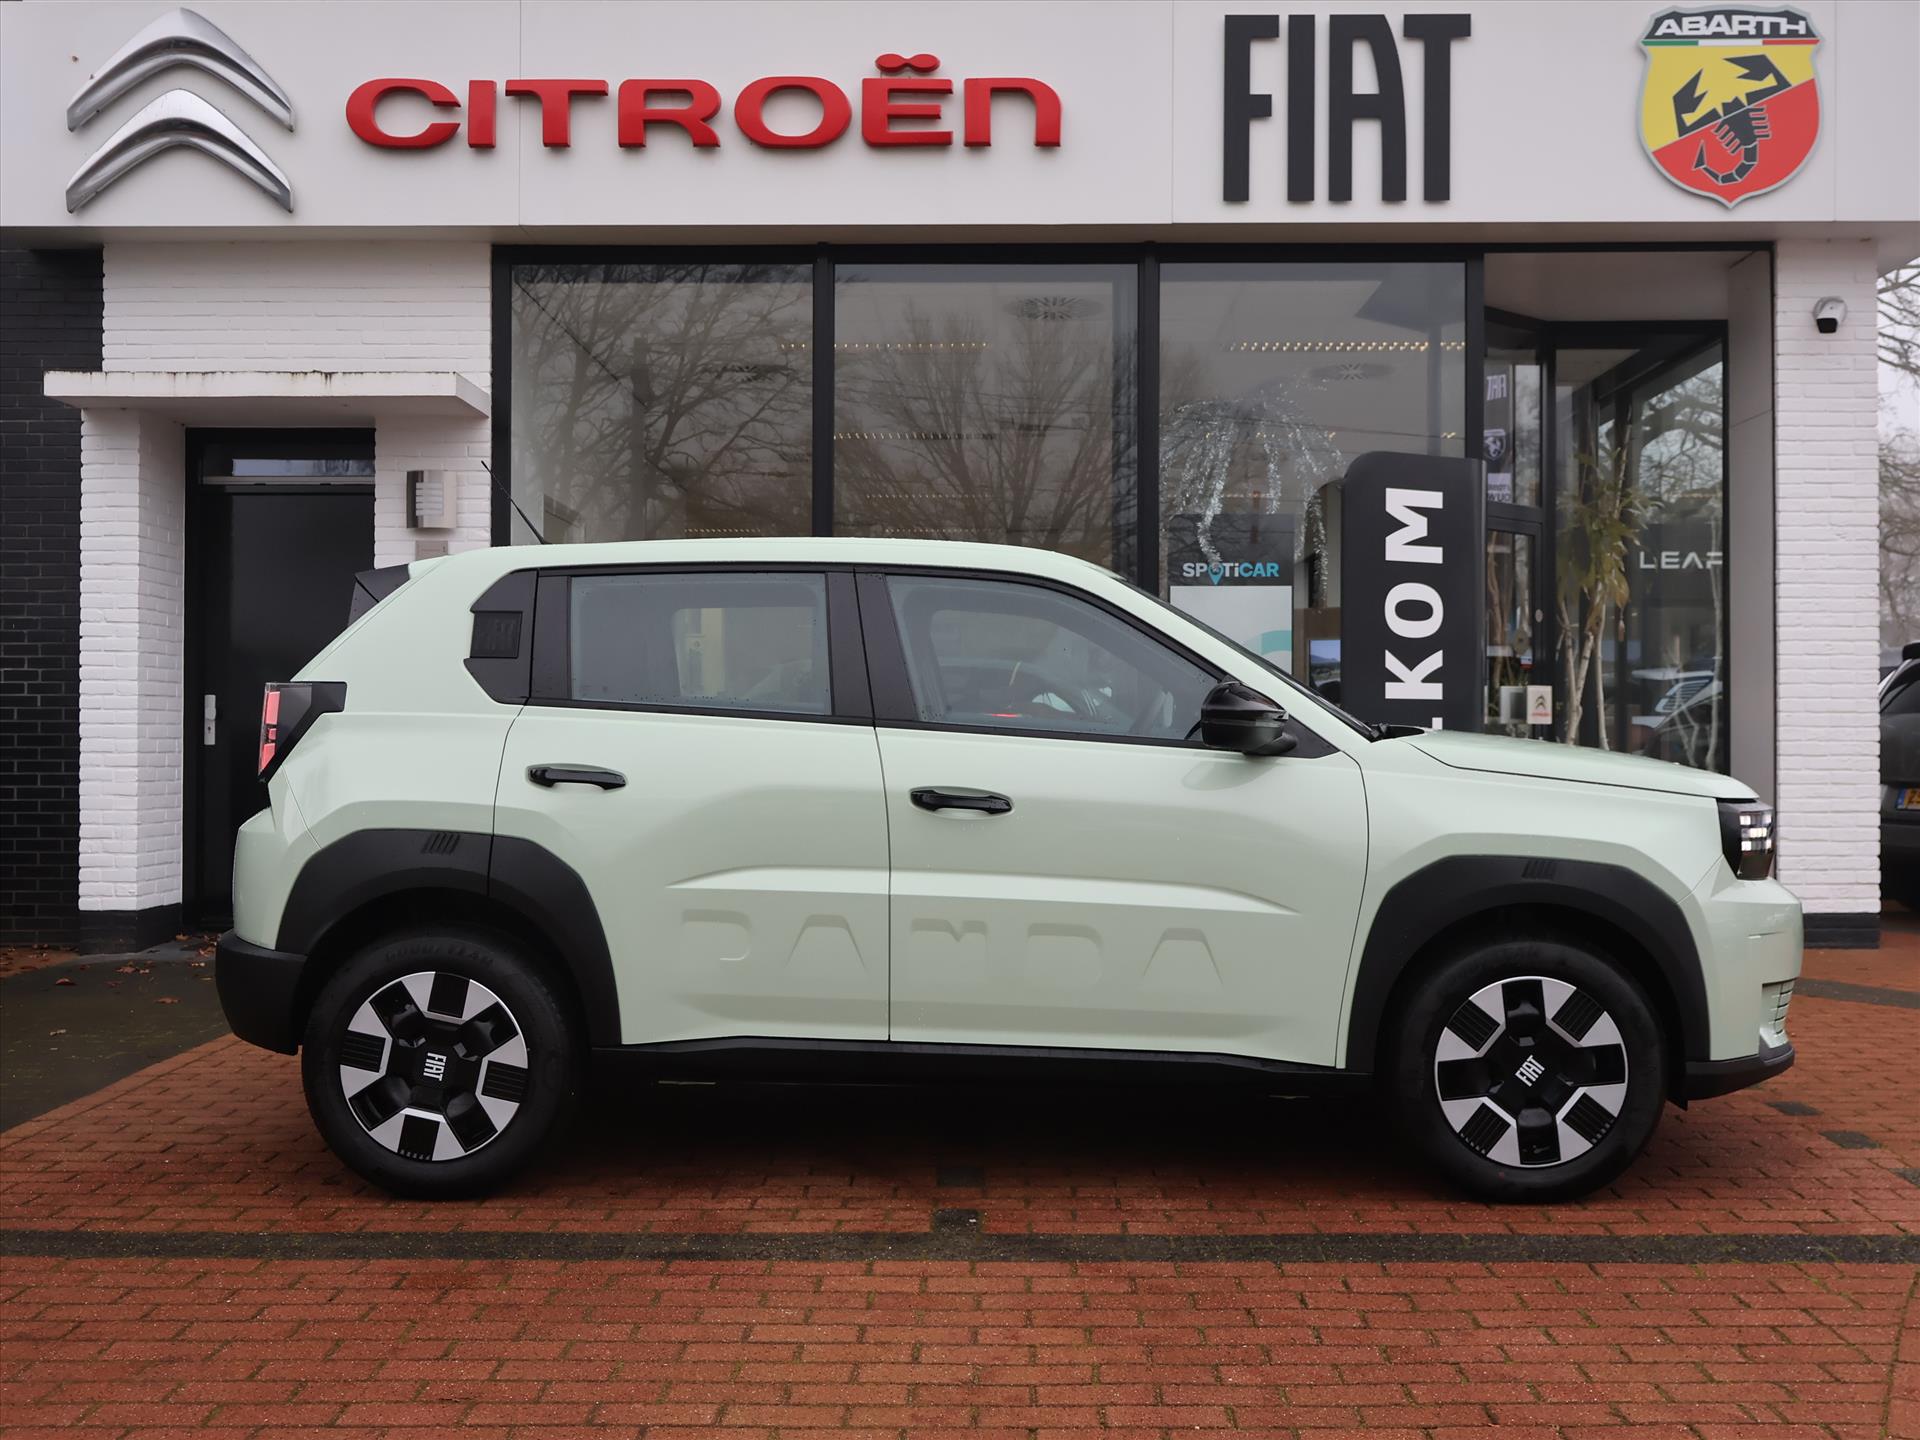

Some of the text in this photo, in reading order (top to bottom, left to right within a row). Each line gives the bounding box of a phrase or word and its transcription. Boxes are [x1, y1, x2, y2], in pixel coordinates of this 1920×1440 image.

[1655, 14, 1807, 36] ABARTH
[346, 53, 1061, 150] CITROËN
[1223, 14, 1471, 203] FIAT
[1385, 487, 1443, 731] KOM
[423, 1052, 447, 1081] FIAT
[1514, 1055, 1545, 1087] FIAT
